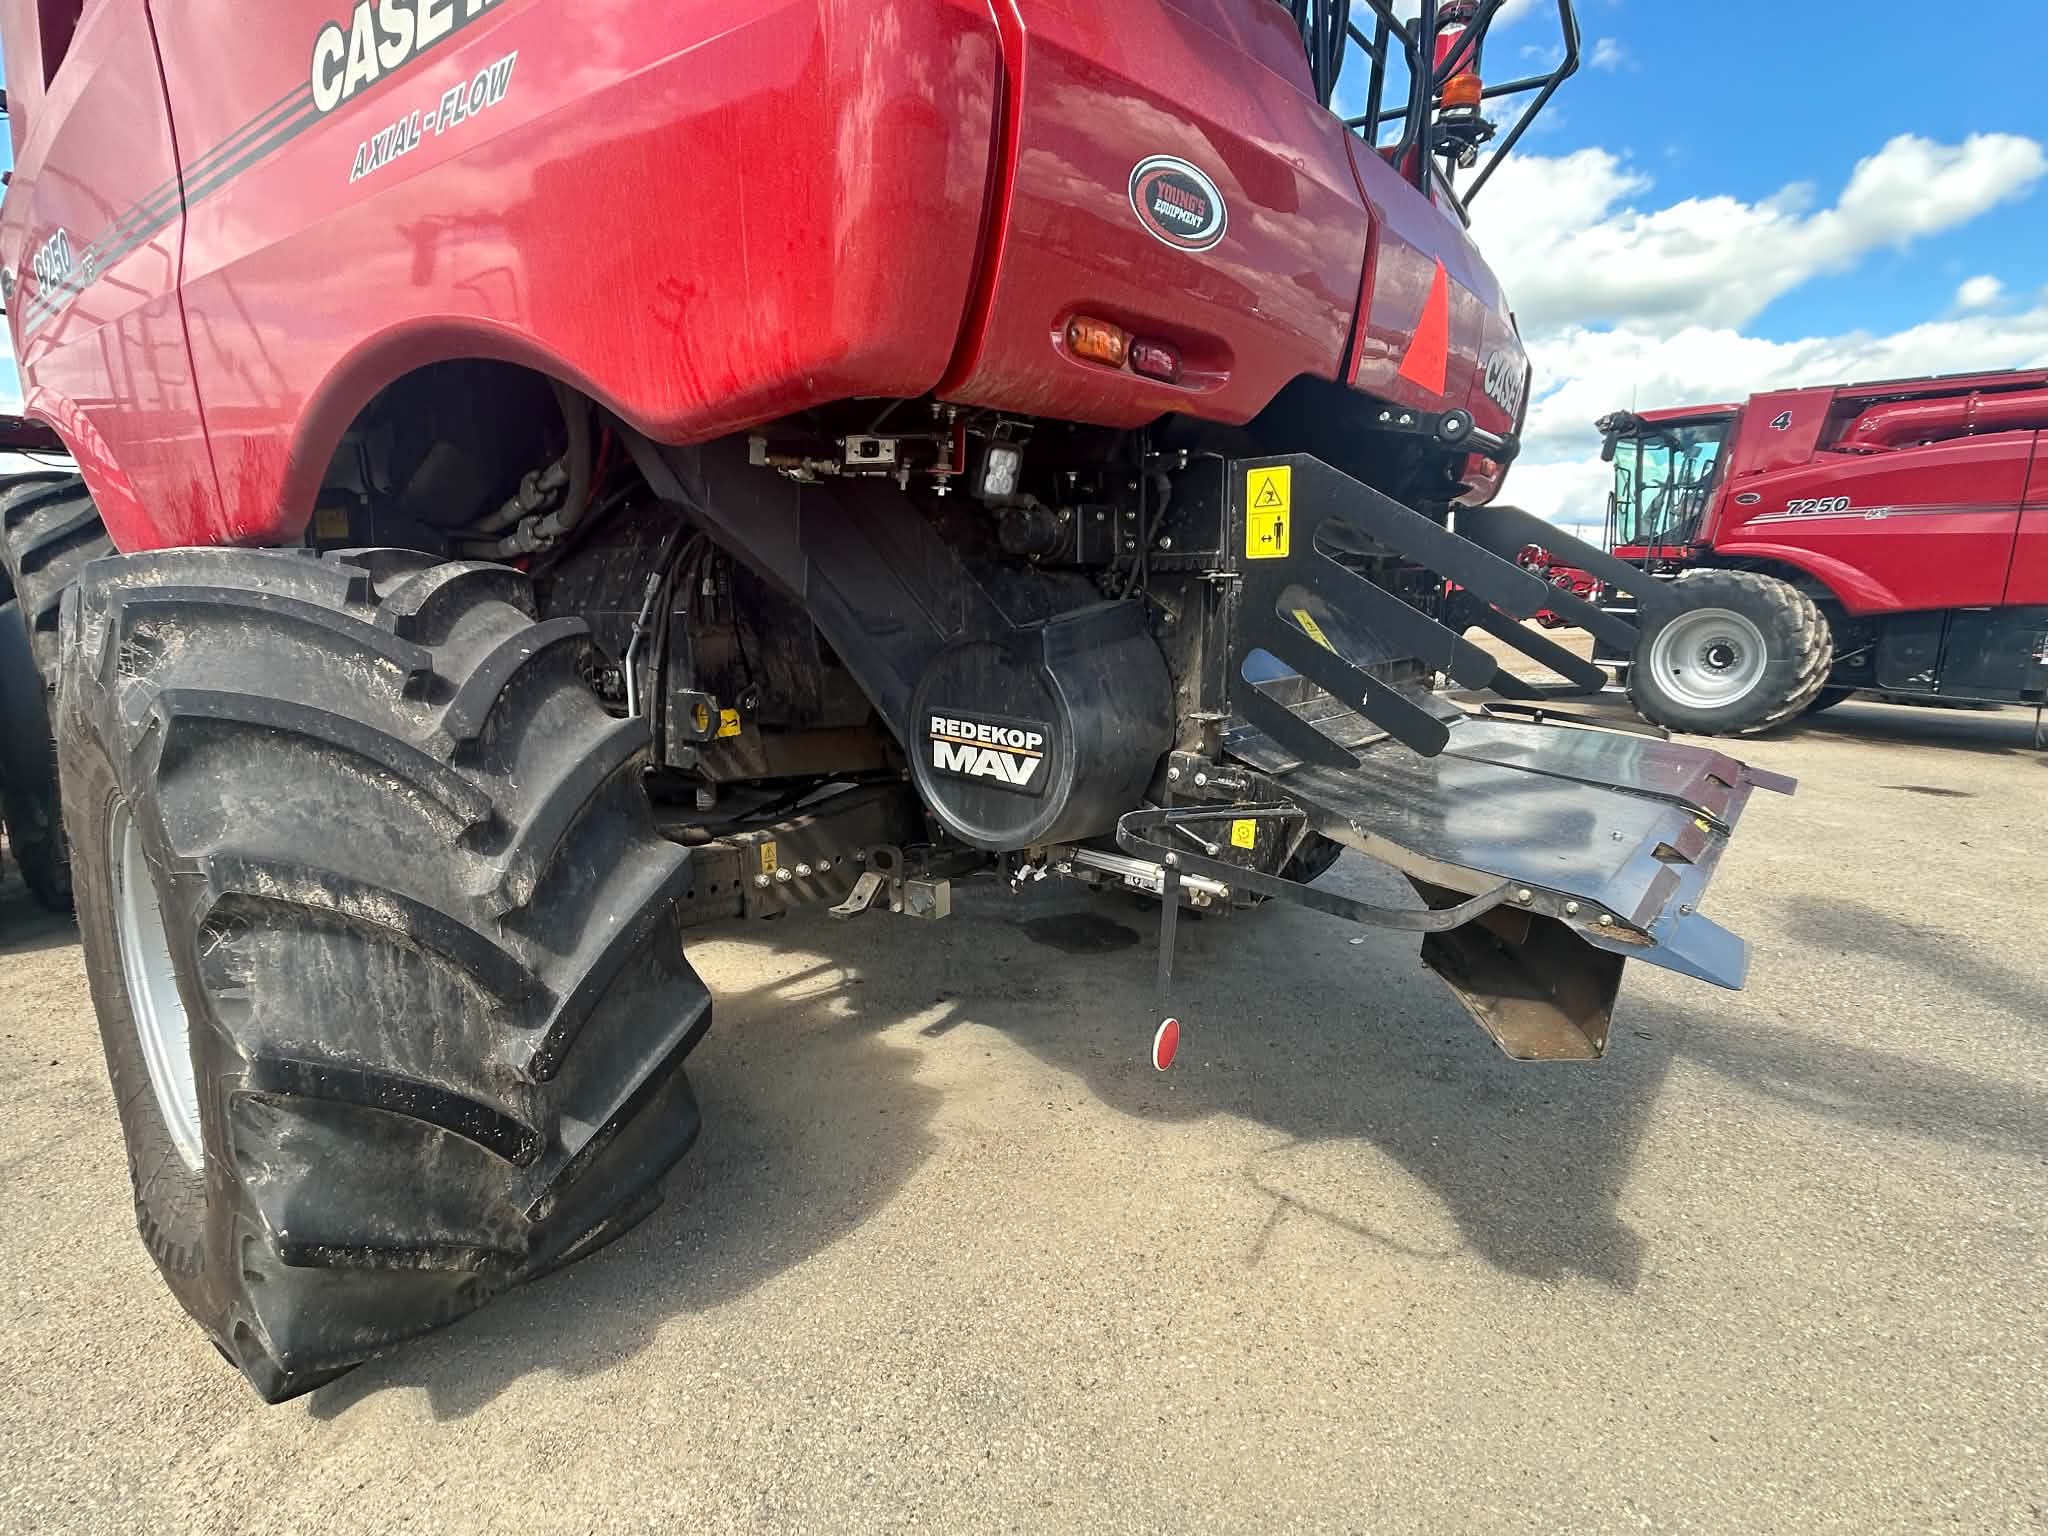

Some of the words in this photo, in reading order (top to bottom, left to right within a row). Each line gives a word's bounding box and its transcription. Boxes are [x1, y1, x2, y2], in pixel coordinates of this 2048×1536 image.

[311, 0, 454, 112] CASE
[349, 50, 519, 184] AXIAL-FLOW
[1153, 198, 1204, 228] EQUIPMENT
[1157, 180, 1206, 217] YOUNG'S
[1769, 410, 1793, 431] 4
[1785, 496, 1851, 516] 7250
[930, 715, 1044, 749] REDEKOP
[932, 739, 1041, 786] MAV
